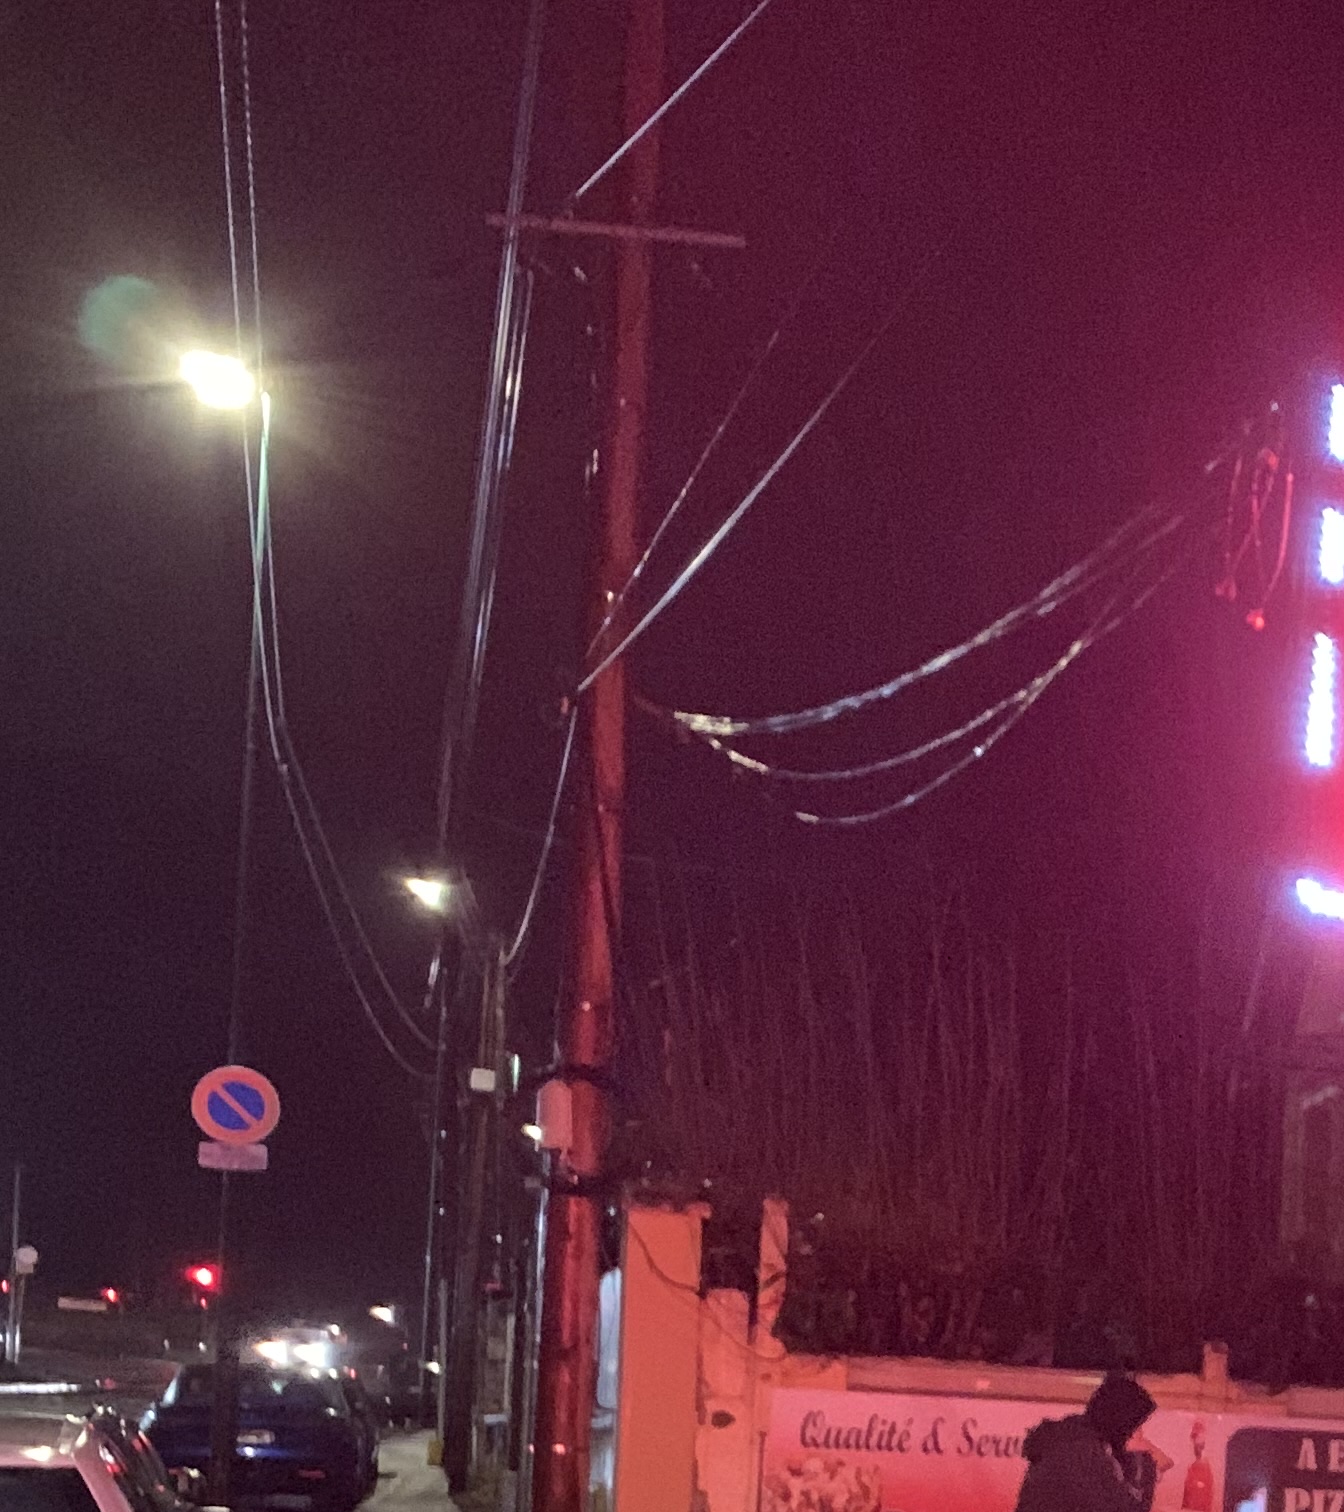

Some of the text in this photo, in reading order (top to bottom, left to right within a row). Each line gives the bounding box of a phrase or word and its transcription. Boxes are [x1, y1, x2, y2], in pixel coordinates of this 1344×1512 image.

[802, 1410, 1024, 1457] Qualité & Serv
[1297, 1438, 1318, 1471] A
